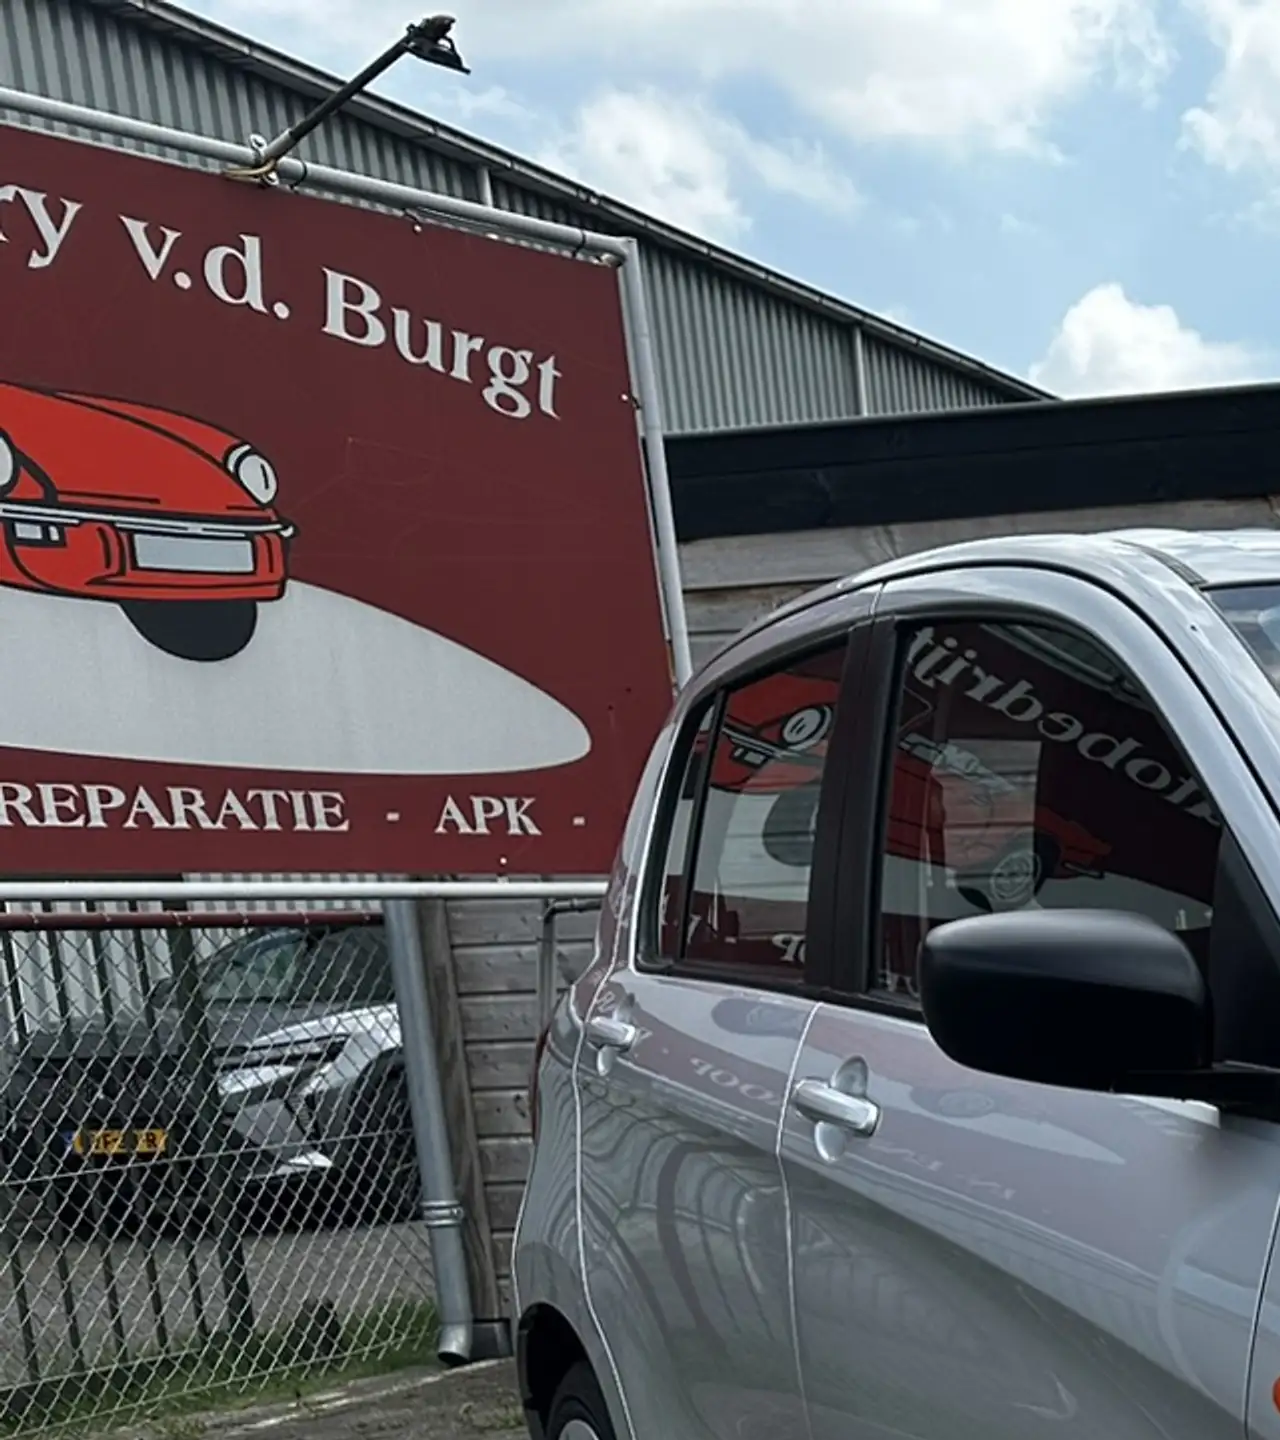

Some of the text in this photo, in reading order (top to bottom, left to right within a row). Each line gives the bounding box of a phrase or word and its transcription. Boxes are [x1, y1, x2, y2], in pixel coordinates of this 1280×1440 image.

[119, 215, 290, 320] v.d.
[322, 267, 562, 419] Burgt
[0, 782, 349, 832] REPARATIE
[435, 795, 541, 836] APK
